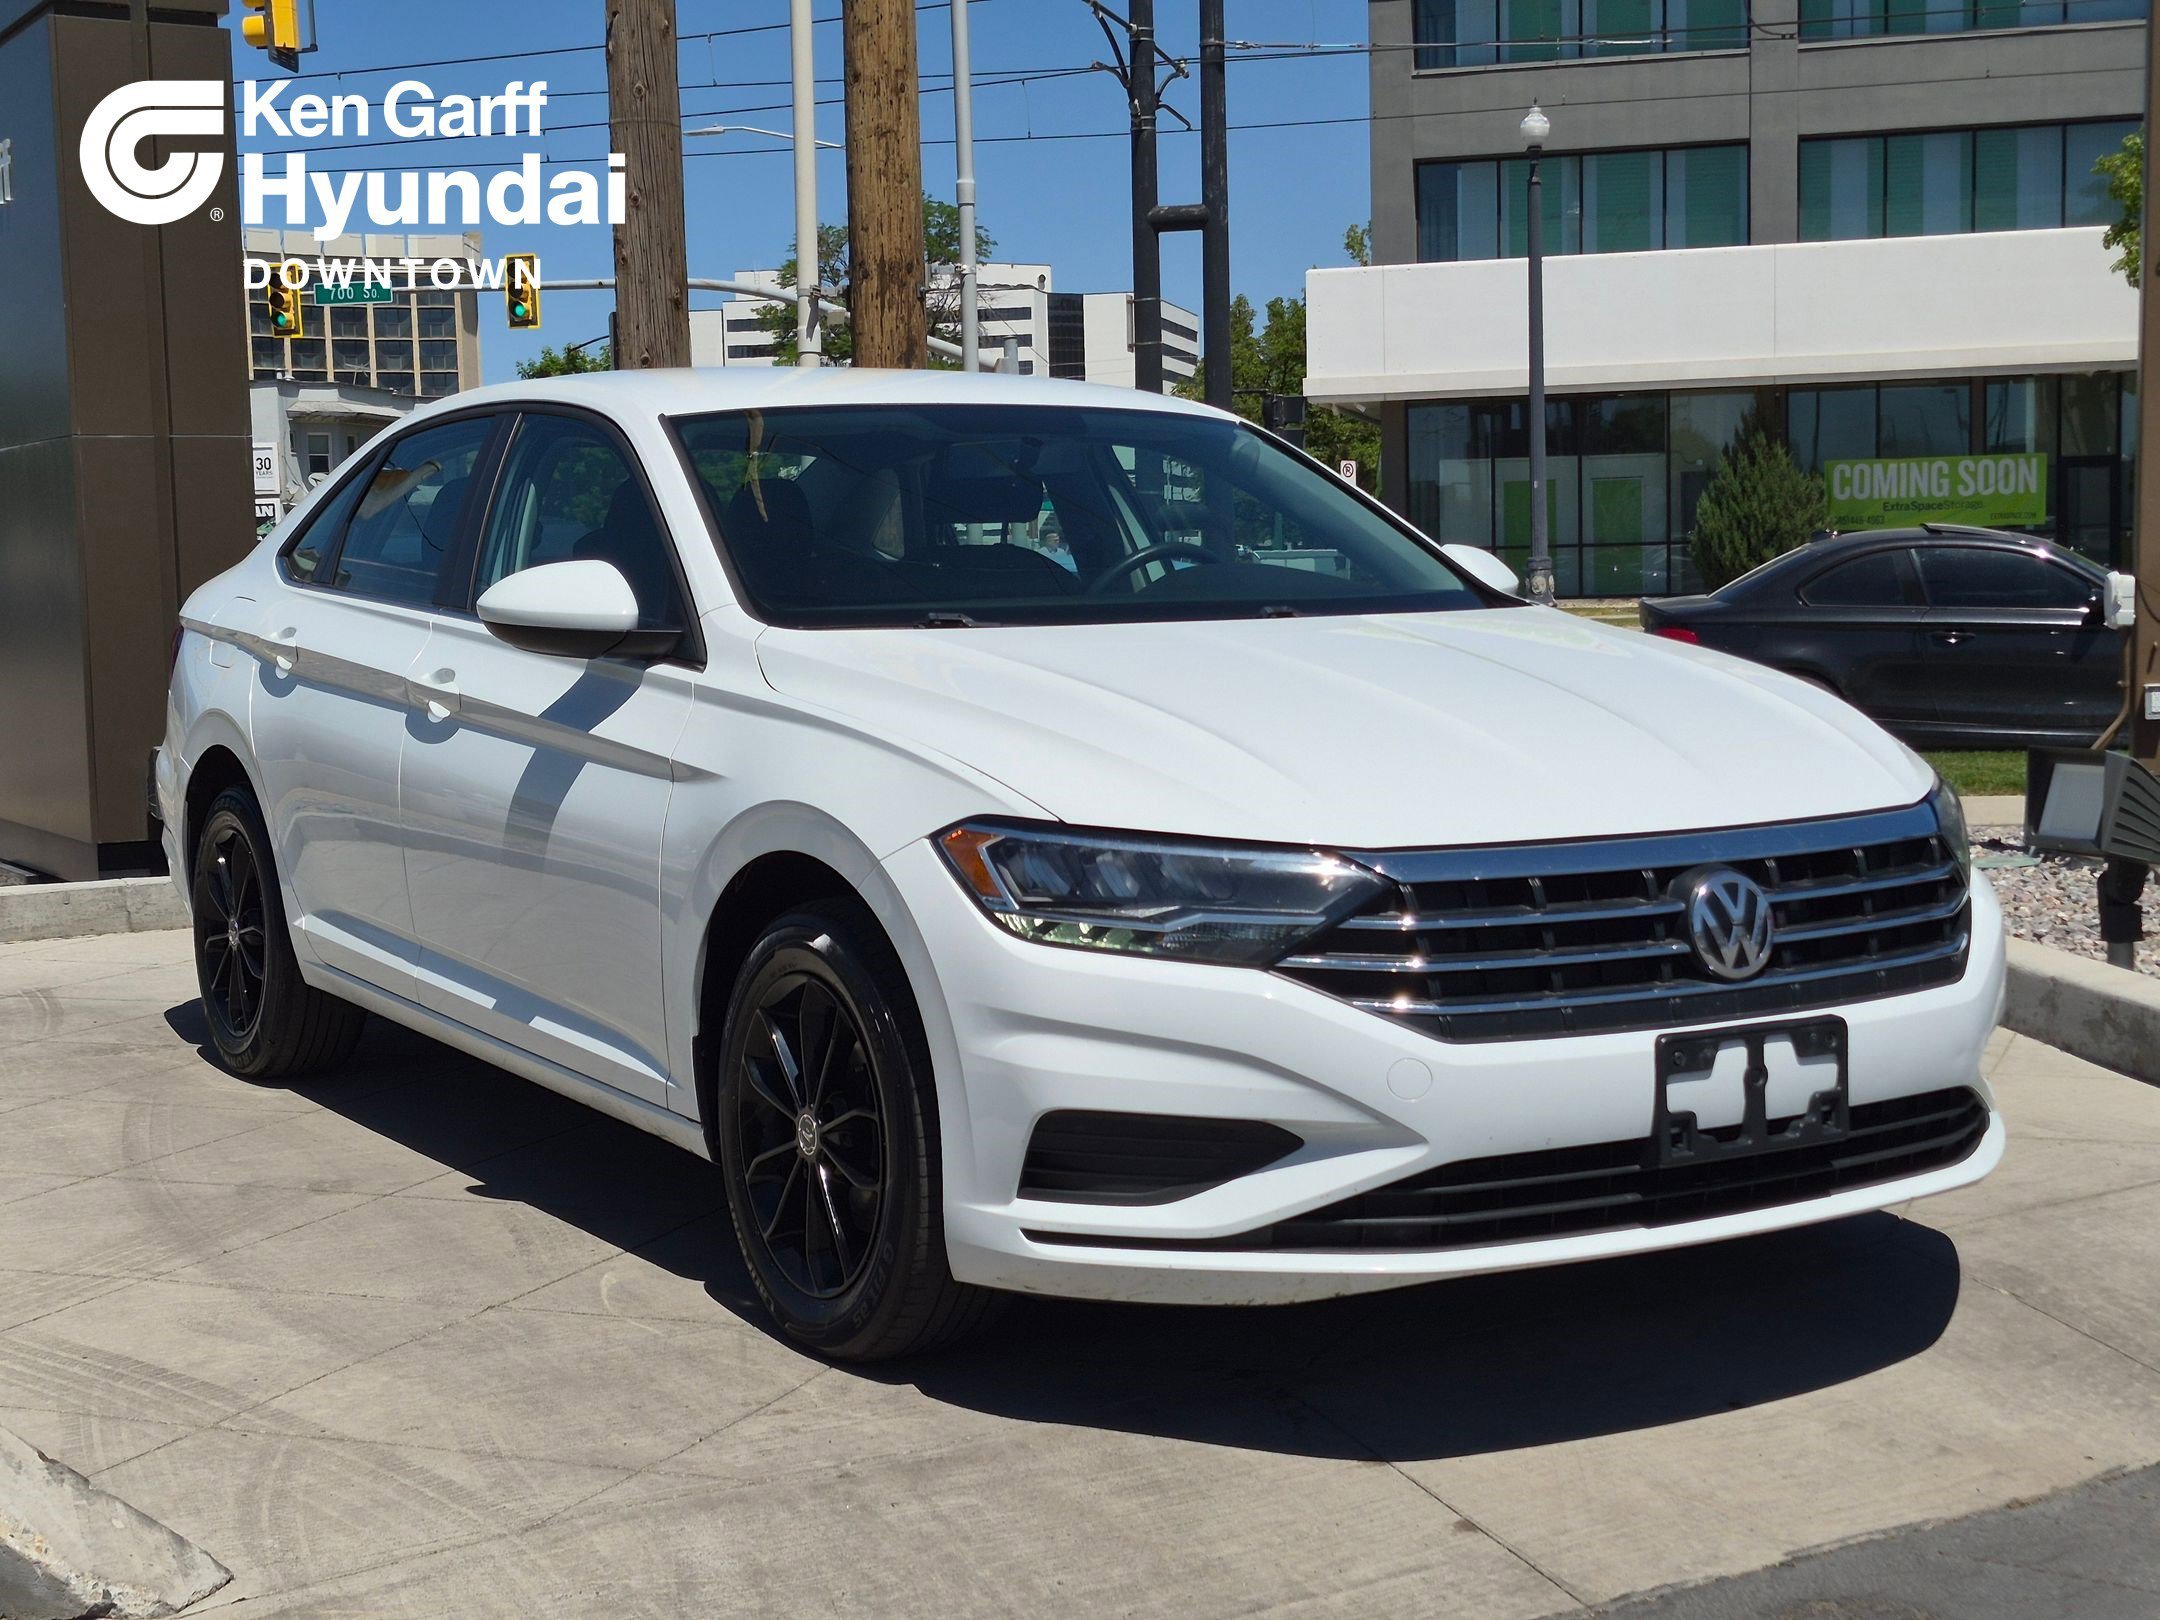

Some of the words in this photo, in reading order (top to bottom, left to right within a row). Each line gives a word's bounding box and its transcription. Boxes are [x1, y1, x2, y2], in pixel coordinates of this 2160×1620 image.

[330, 286, 354, 300] 700
[255, 457, 272, 471] 30
[1833, 460, 1949, 500] COMING
[1957, 458, 2038, 497] SOON
